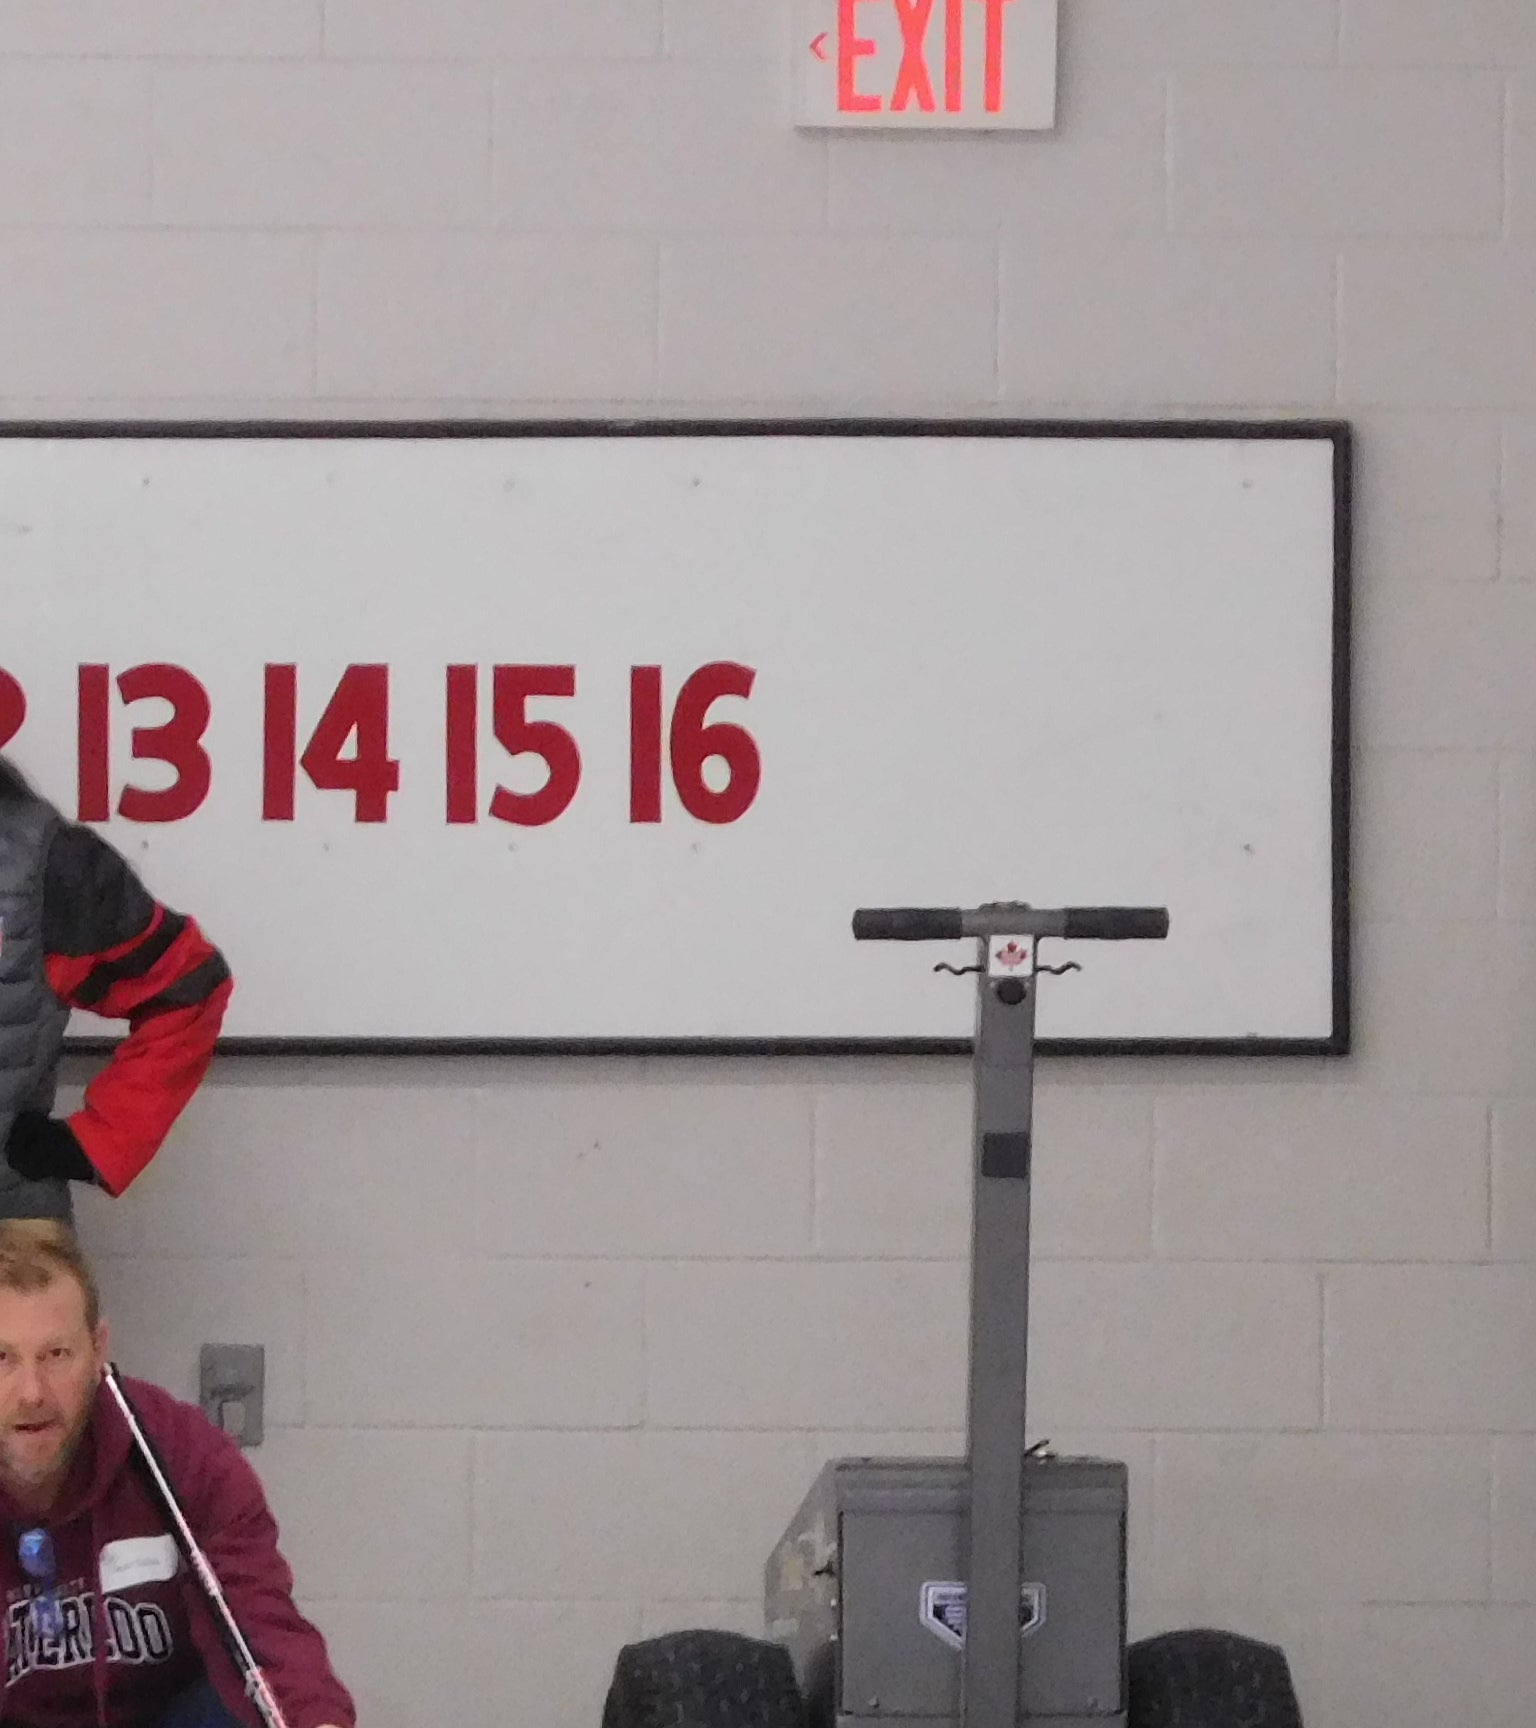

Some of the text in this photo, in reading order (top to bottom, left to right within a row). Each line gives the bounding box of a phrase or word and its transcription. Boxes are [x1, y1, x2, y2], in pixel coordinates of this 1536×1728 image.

[836, 0, 1010, 112] EXIT
[77, 663, 211, 823] 13
[262, 664, 400, 823] 14
[445, 664, 581, 827] 15
[629, 661, 761, 825] 16
